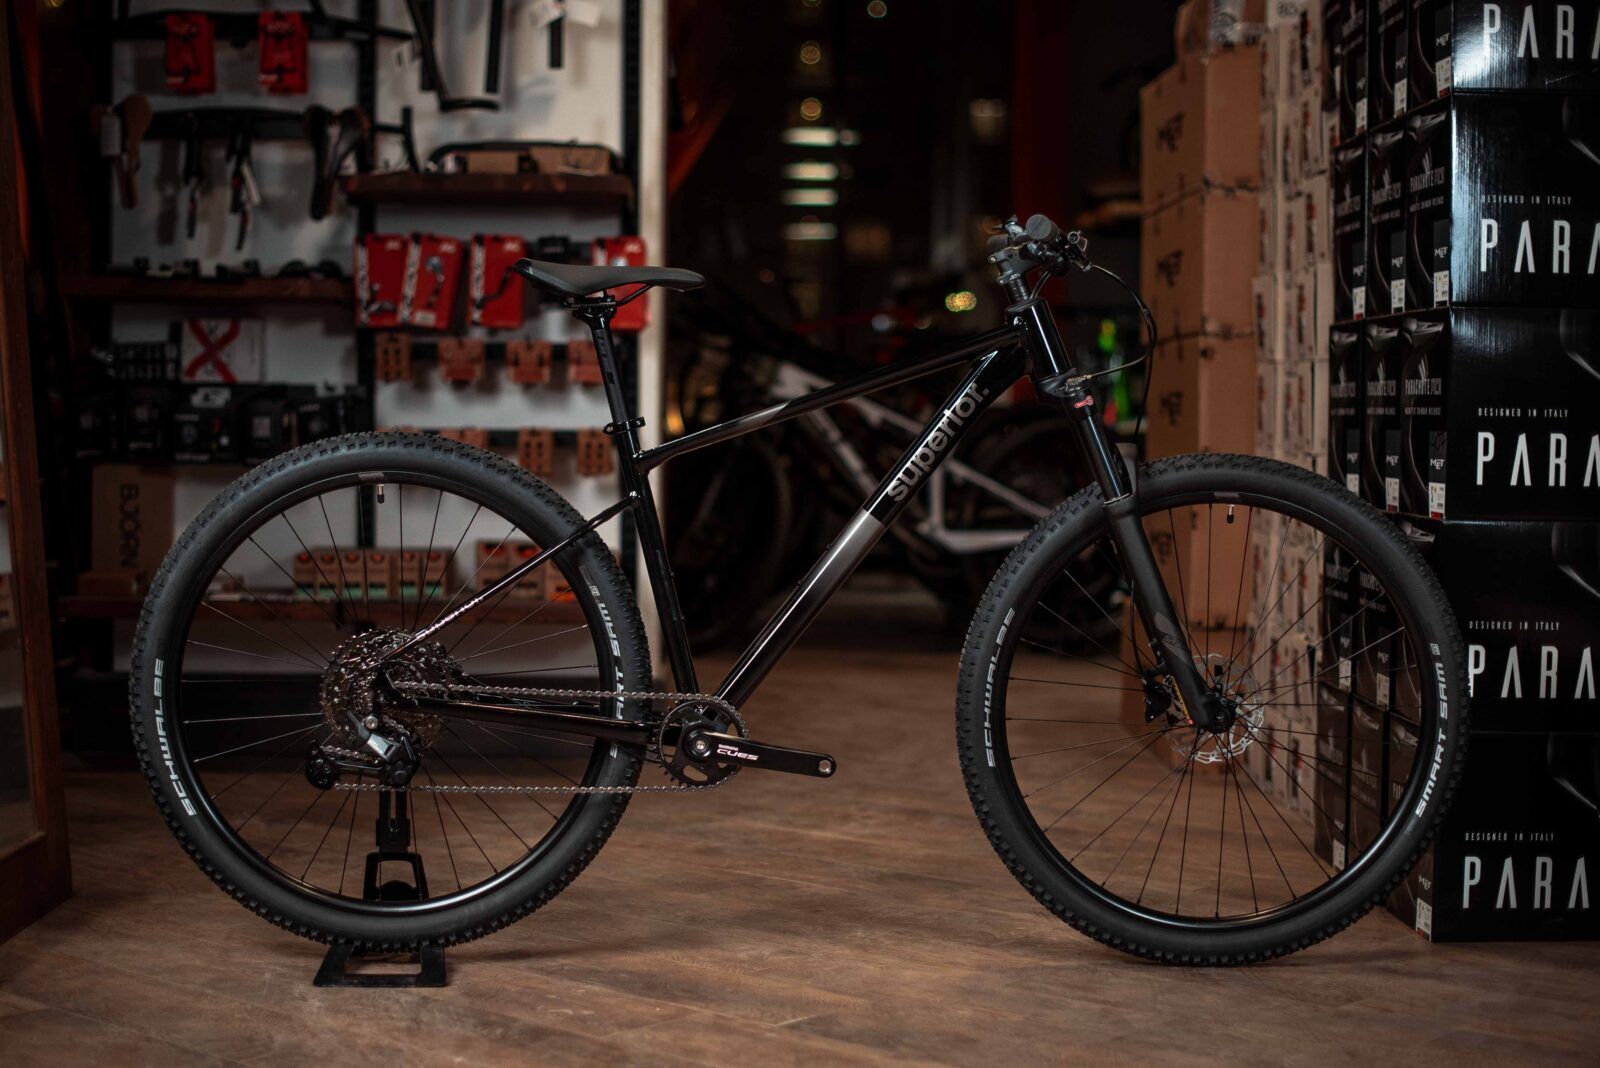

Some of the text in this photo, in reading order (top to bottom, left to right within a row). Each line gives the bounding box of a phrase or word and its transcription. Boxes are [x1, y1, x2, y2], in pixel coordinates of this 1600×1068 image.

[1481, 194, 1572, 206] DESIGNED IN ITALY
[1434, 246, 1449, 258] MET
[1478, 407, 1569, 419] DESIGNED IN ITALY
[1430, 458, 1446, 470] MET
[1469, 620, 1560, 631] DESIGNED IN ITALY
[1467, 644, 1597, 699] PARA
[598, 602, 625, 759] SART SAM
[984, 607, 1016, 768] SCHWALBE
[153, 657, 197, 816] SCHWALBE
[1414, 727, 1447, 818] SMART
[1435, 662, 1448, 720] SAM
[716, 748, 760, 761] CUES
[1465, 831, 1555, 841] DESIGNED IN ITALY
[1462, 855, 1591, 909] PARA
